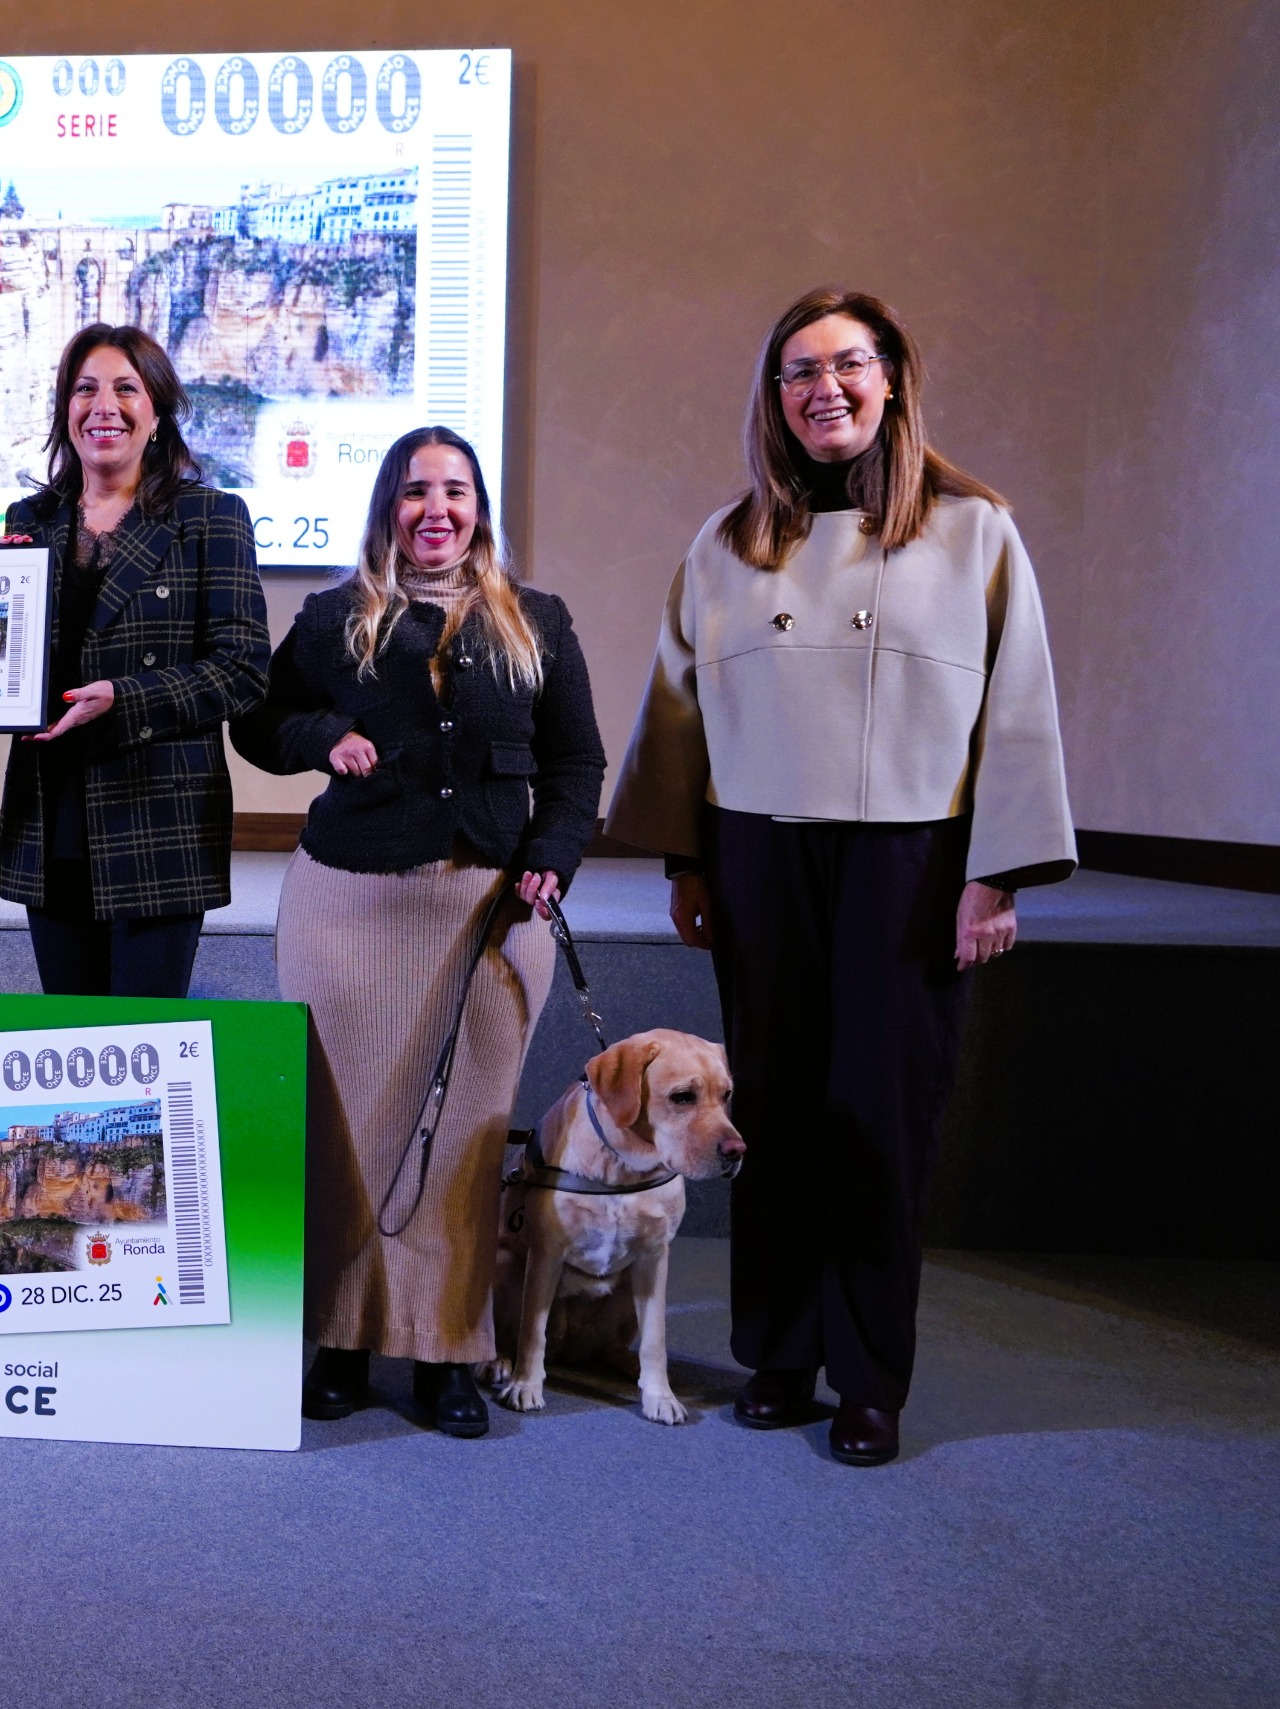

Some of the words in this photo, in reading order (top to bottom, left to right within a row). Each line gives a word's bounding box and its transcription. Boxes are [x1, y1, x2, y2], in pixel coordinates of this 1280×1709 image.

[52, 58, 126, 96] 000
[459, 53, 490, 85] 2€
[161, 54, 421, 136] 00000
[57, 114, 117, 137] SERIE
[338, 443, 388, 463] Ron
[253, 516, 282, 548] C.
[293, 516, 329, 548] 25
[20, 575, 31, 584] 2€
[69, 1048, 83, 1066] ONCE
[101, 1046, 115, 1064] ONCE
[133, 1045, 147, 1062] ONCE
[179, 1041, 199, 1058] 2€
[3, 1043, 160, 1091] 00000
[5, 1052, 19, 1069] ONCE
[37, 1050, 51, 1068] ONCE
[14, 1071, 29, 1090] ONCE
[46, 1070, 61, 1088] ONCE
[78, 1068, 93, 1086] ONCE
[111, 1066, 125, 1084] ONCE
[142, 1064, 157, 1083] ONCE
[145, 1087, 152, 1096] R
[115, 1237, 161, 1246] Ayuntamiento
[123, 1243, 165, 1256] Ronda
[21, 1287, 45, 1305] 28
[51, 1285, 94, 1304] DIC.
[99, 1283, 123, 1301] 25
[4, 1361, 58, 1378] social
